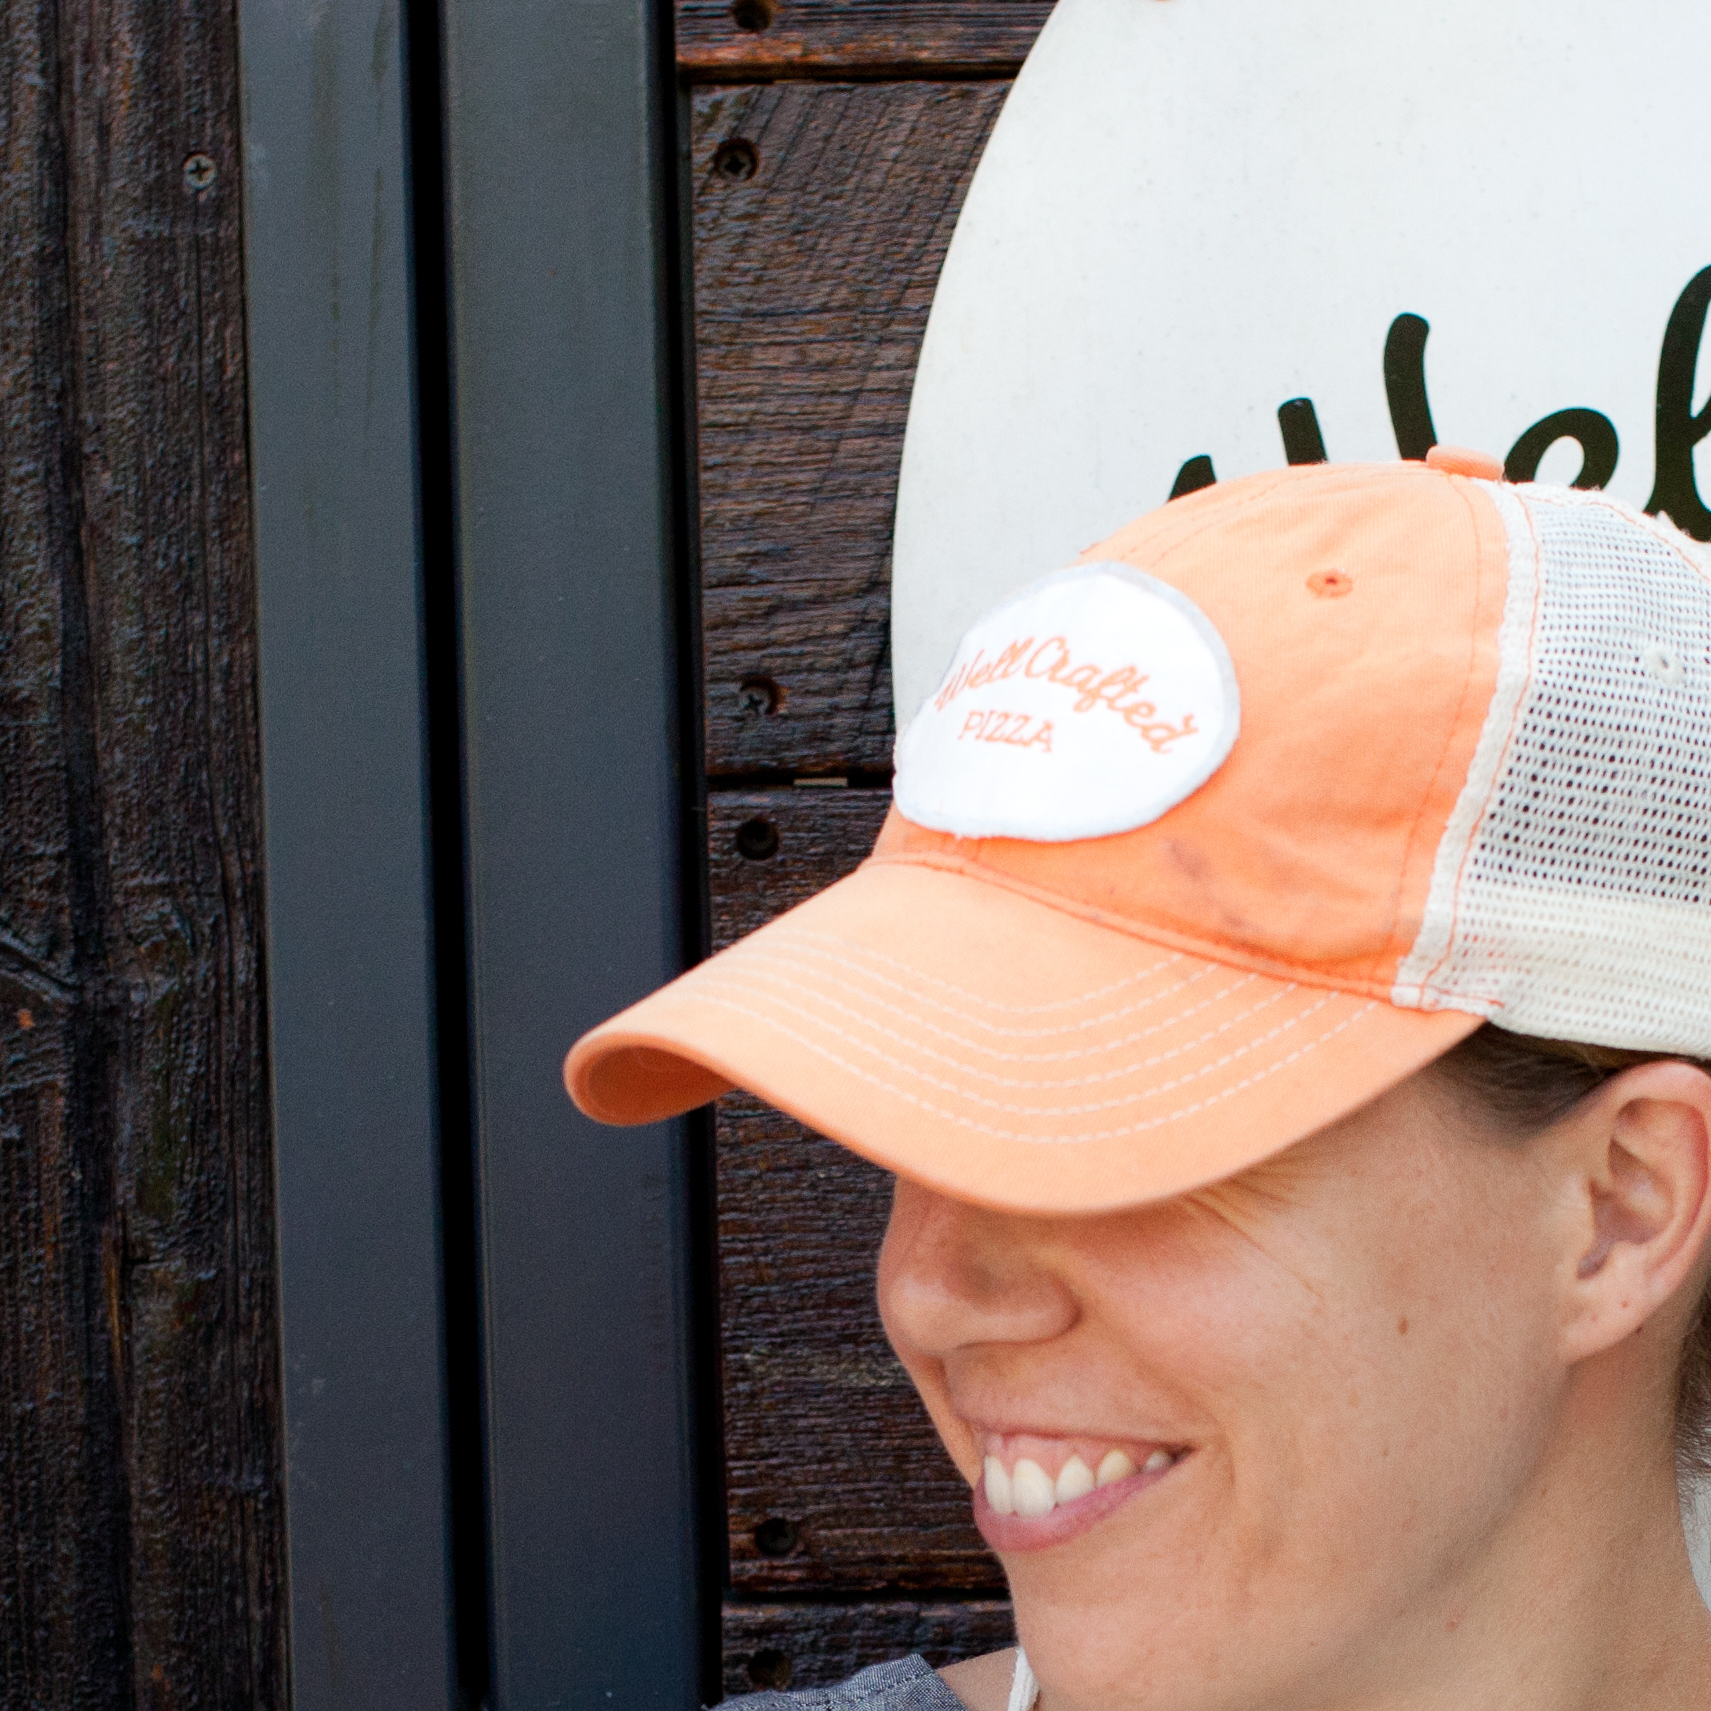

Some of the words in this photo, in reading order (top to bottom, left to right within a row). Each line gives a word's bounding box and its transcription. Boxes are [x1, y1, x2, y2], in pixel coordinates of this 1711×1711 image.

[934, 636, 1035, 712] Well
[1024, 635, 1199, 754] Crafted
[957, 709, 1053, 752] PIZZA
